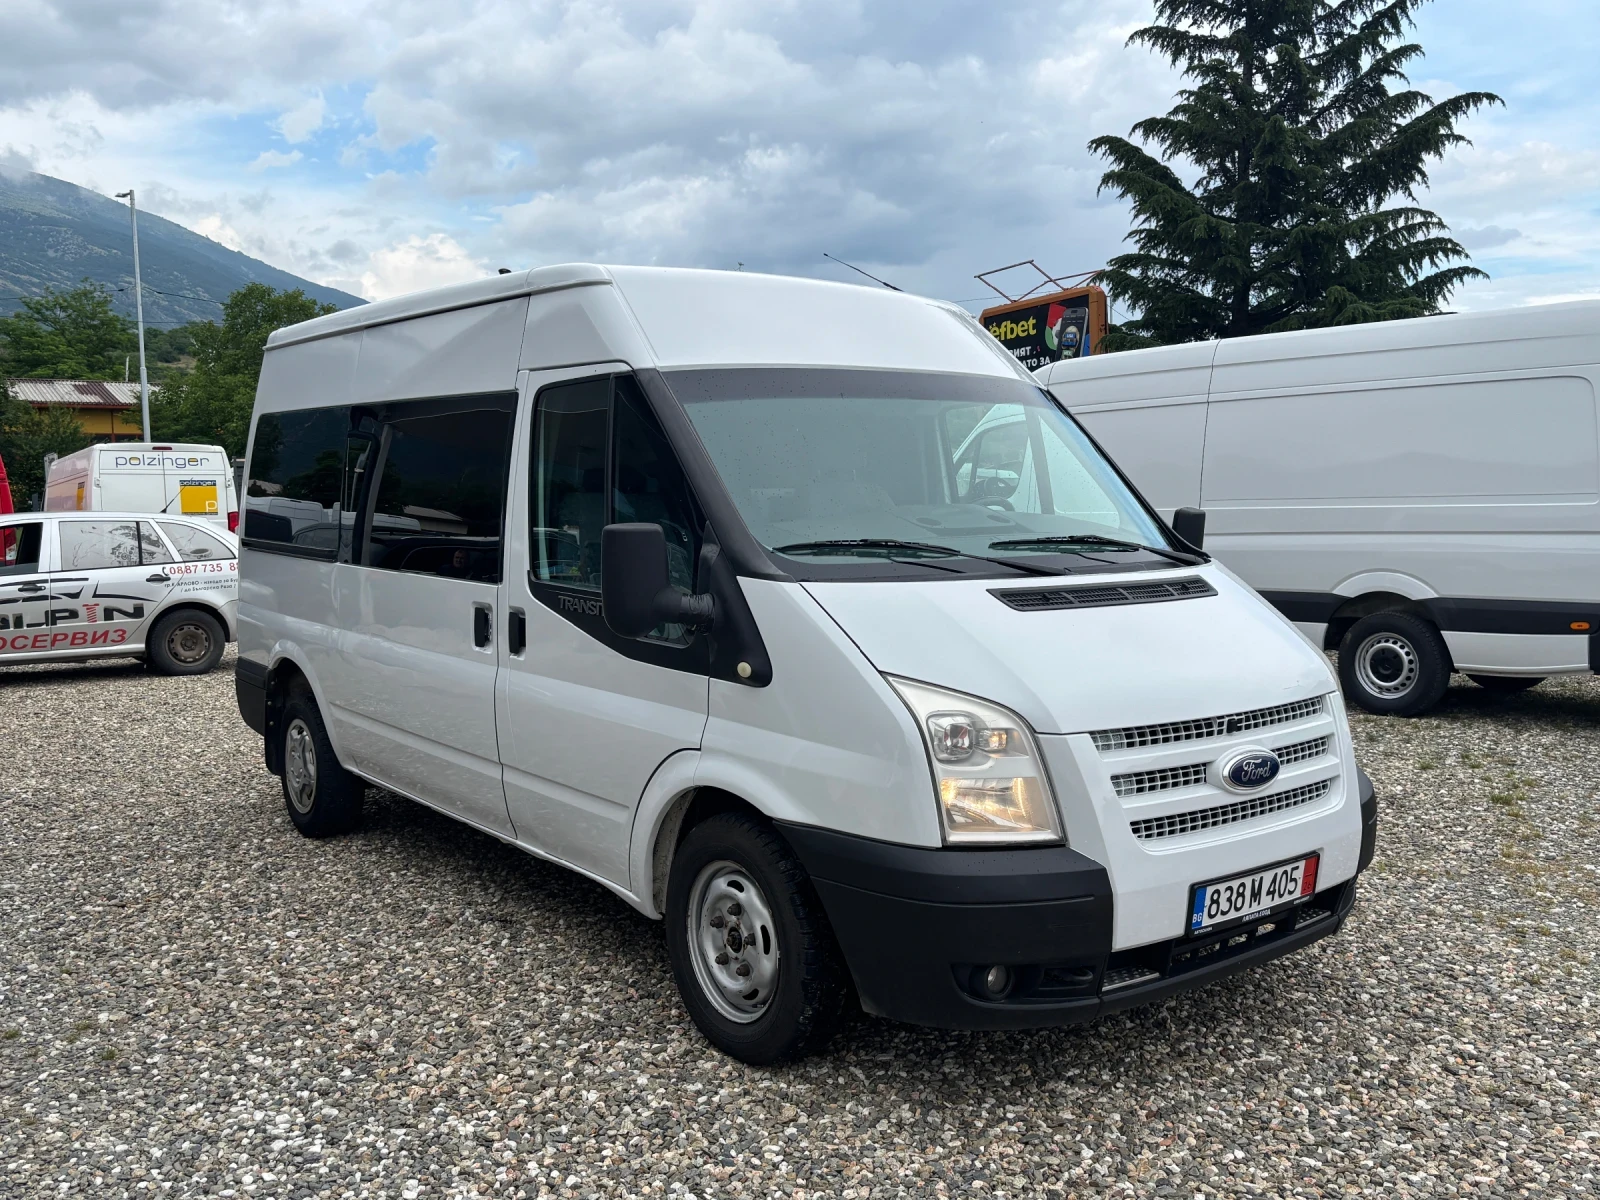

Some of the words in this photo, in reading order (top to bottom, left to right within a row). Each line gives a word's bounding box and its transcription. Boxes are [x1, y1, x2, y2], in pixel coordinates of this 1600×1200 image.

[989, 316, 1037, 341] efbet
[1039, 356, 1051, 366] ЗА
[115, 454, 210, 469] polzinger
[169, 564, 198, 575] 0887
[201, 563, 223, 573] 735
[1241, 758, 1272, 782] Ford
[1207, 881, 1246, 920] 838
[1249, 875, 1263, 908] M
[1265, 865, 1300, 902] 405
[1192, 912, 1203, 924] BG
